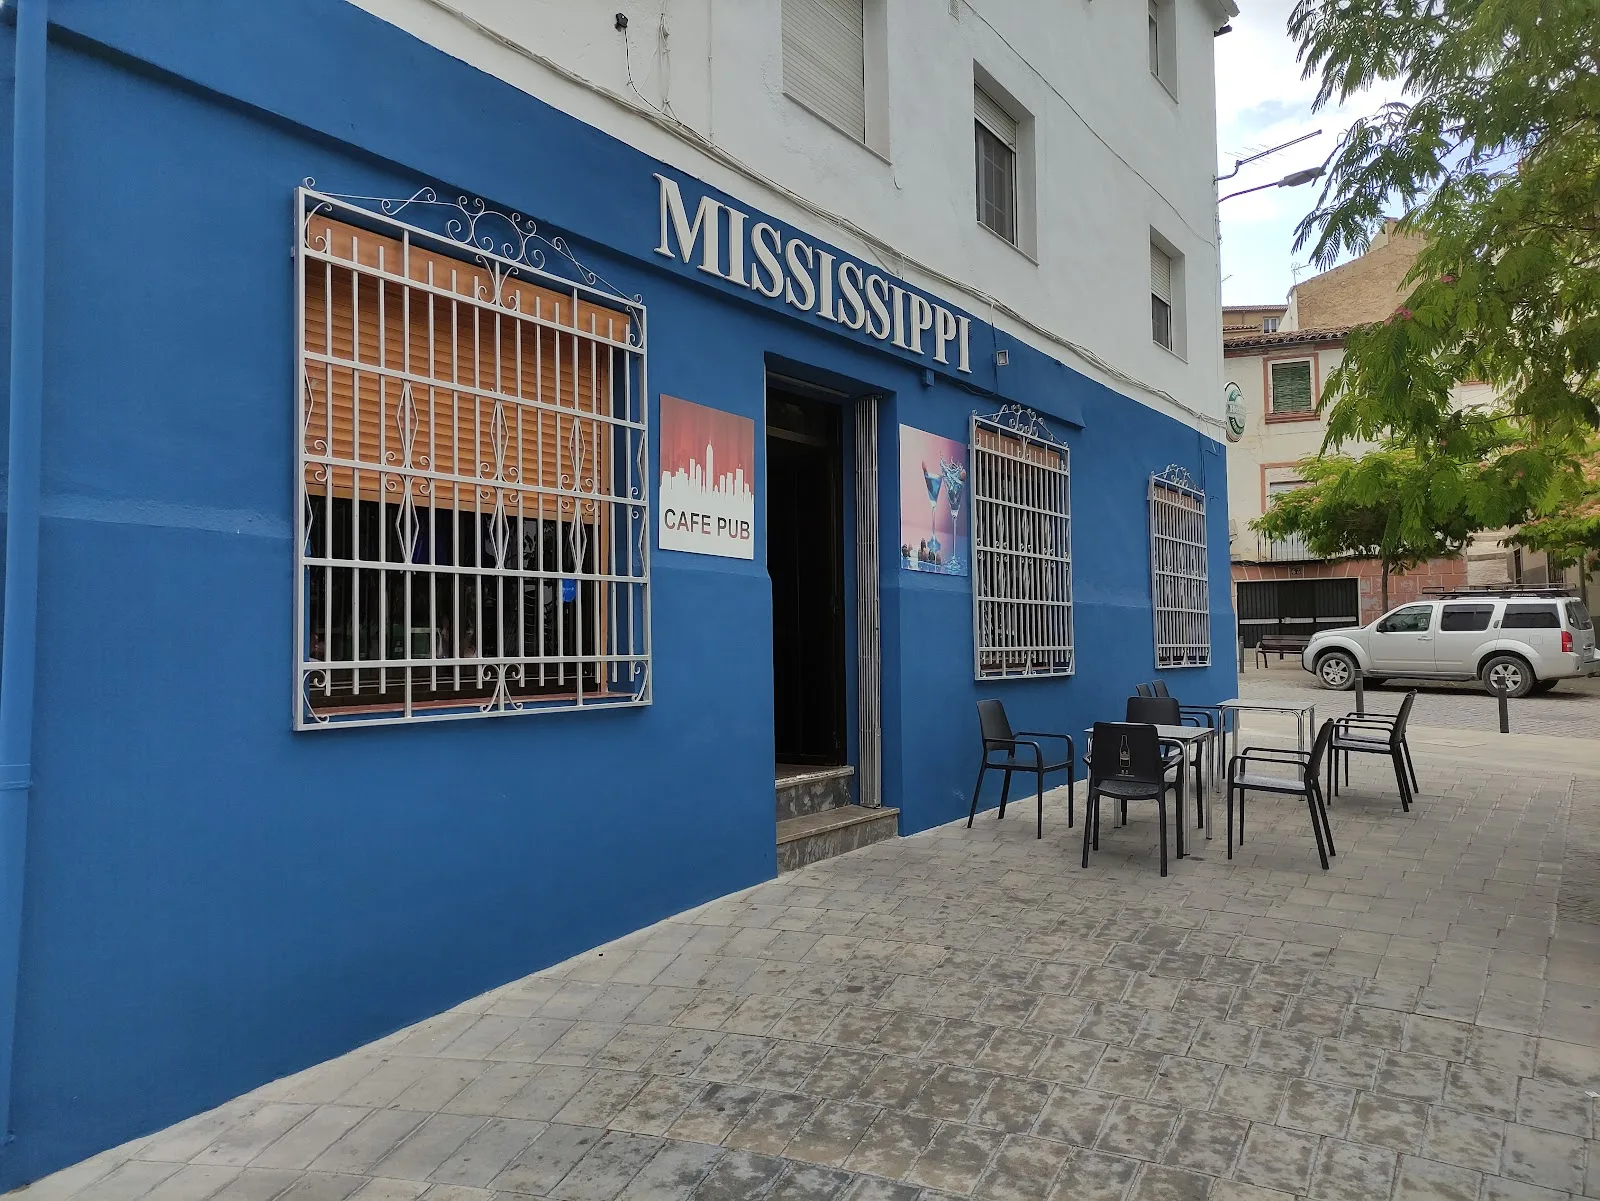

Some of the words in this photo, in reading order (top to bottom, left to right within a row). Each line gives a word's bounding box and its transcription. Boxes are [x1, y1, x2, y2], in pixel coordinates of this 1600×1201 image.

[652, 172, 973, 374] MISSISSIPPI
[664, 508, 711, 535] CAFE
[717, 516, 750, 540] PUB
